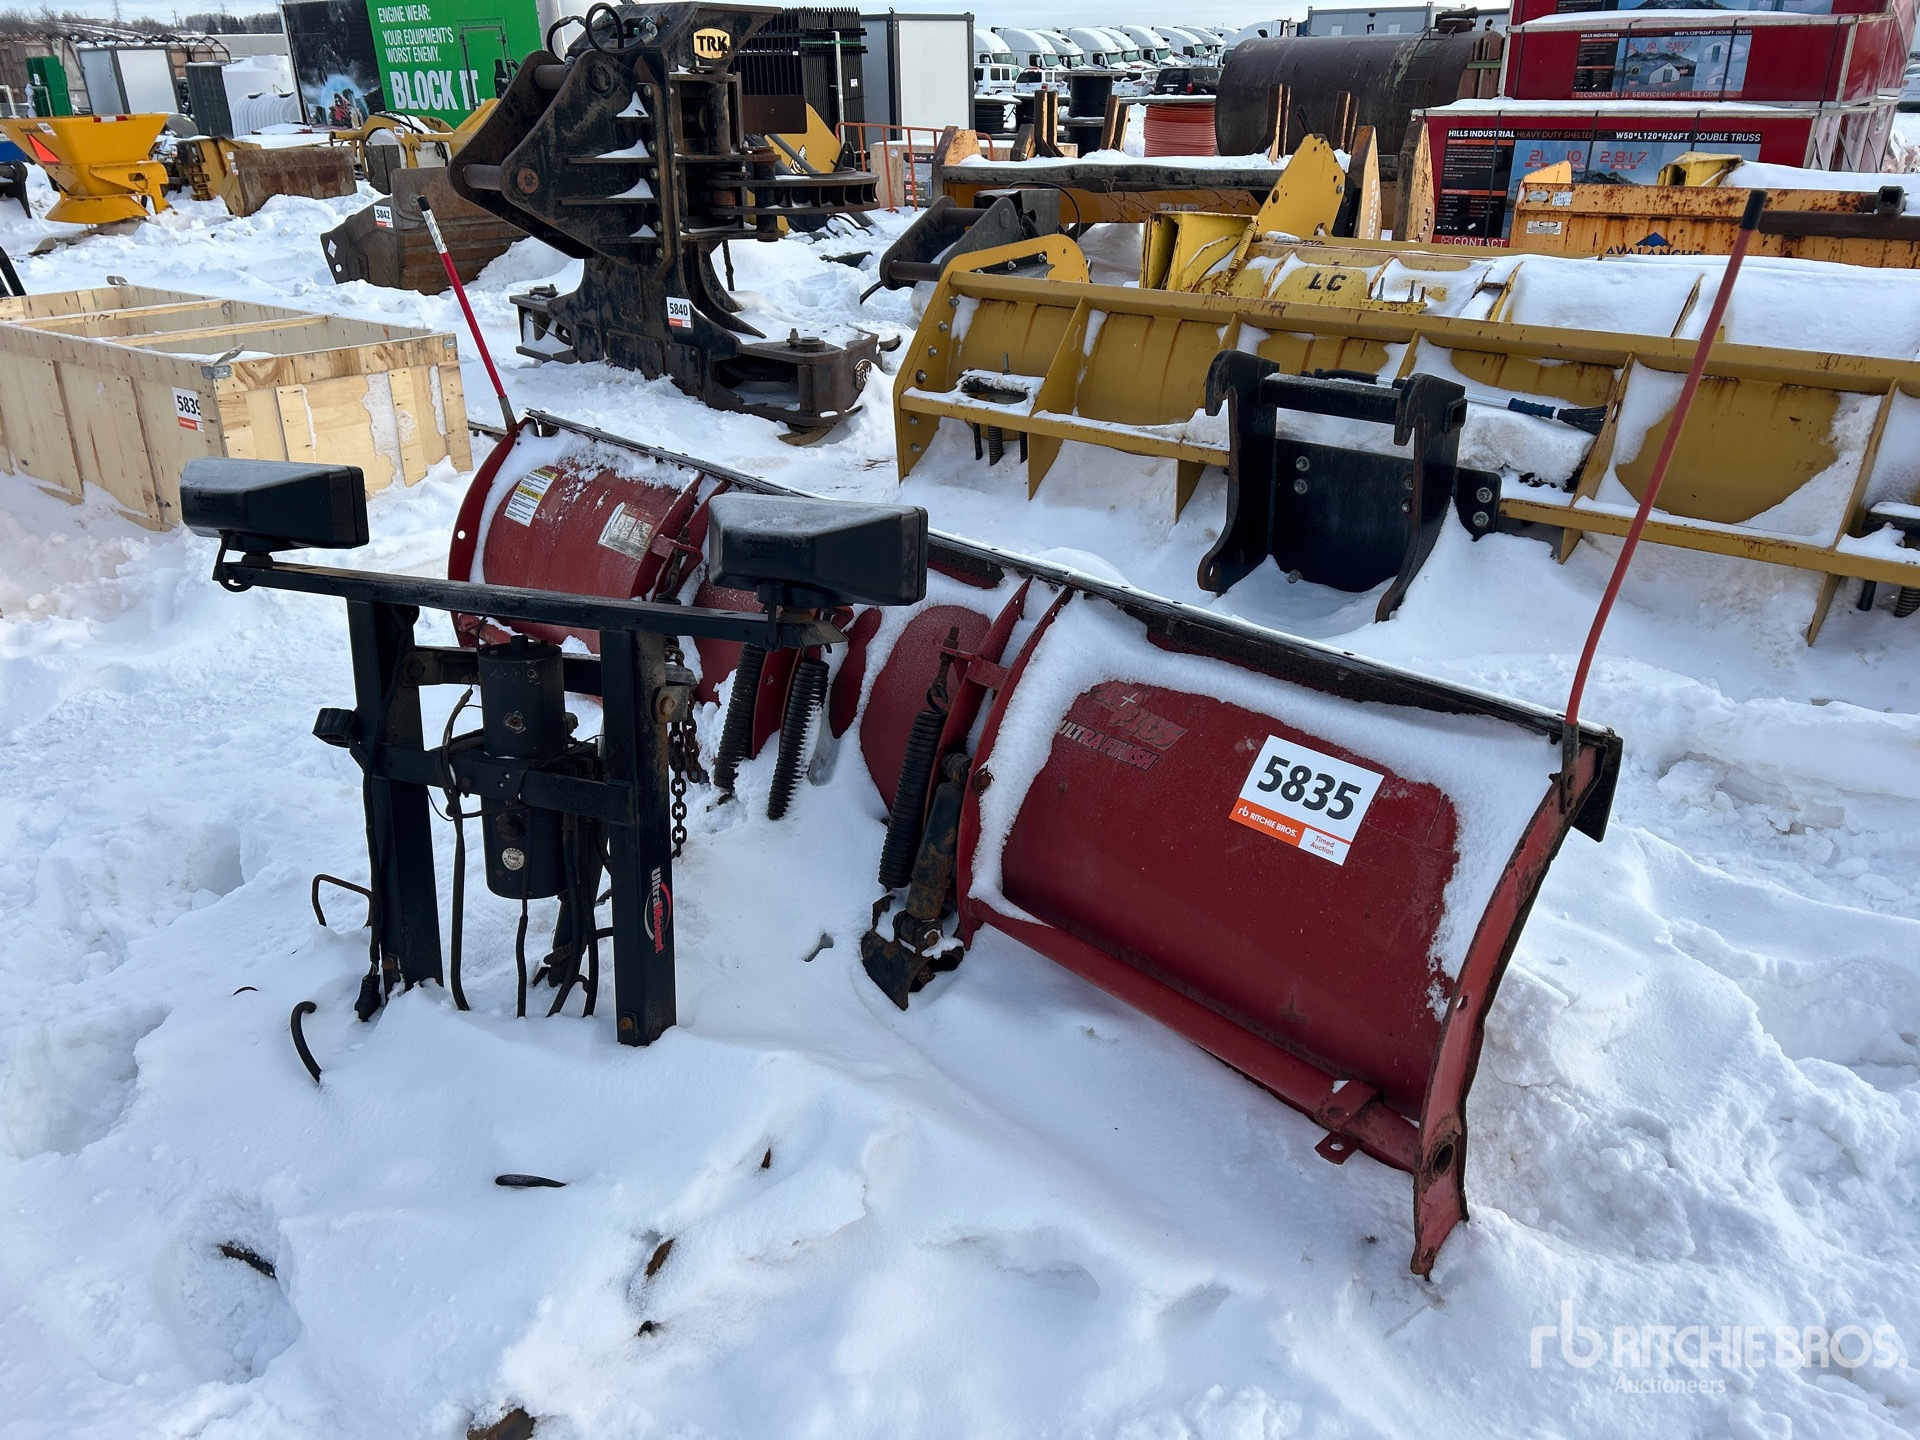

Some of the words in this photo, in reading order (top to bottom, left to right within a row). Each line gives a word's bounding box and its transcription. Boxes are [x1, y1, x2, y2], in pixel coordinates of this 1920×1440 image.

[378, 6, 406, 23] ENGINE
[405, 4, 432, 21] WEAR:
[382, 29, 403, 46] YOUR
[403, 27, 454, 45] EQUIPMENT'S
[696, 35, 727, 52] TRK
[385, 46, 412, 63] WORST
[412, 45, 442, 62] ENEMY.
[389, 69, 459, 111] BLOCK
[1469, 130, 1515, 138] INDUSTRIAL
[1543, 131, 1562, 139] DUTY
[1731, 133, 1761, 142] TRUSS
[1529, 149, 1544, 161] 21
[1566, 150, 1582, 162] 10
[375, 209, 391, 220] 5842
[1454, 237, 1506, 247] CONTACT
[669, 303, 689, 317] 5840
[1058, 719, 1103, 750] ULTRA
[1100, 736, 1160, 772] FINISH
[1256, 755, 1362, 821] 5835
[1250, 812, 1276, 829] RITCHIE
[1276, 823, 1298, 838] BROS.
[1310, 841, 1334, 857] Auction
[1315, 835, 1336, 848] Timed
